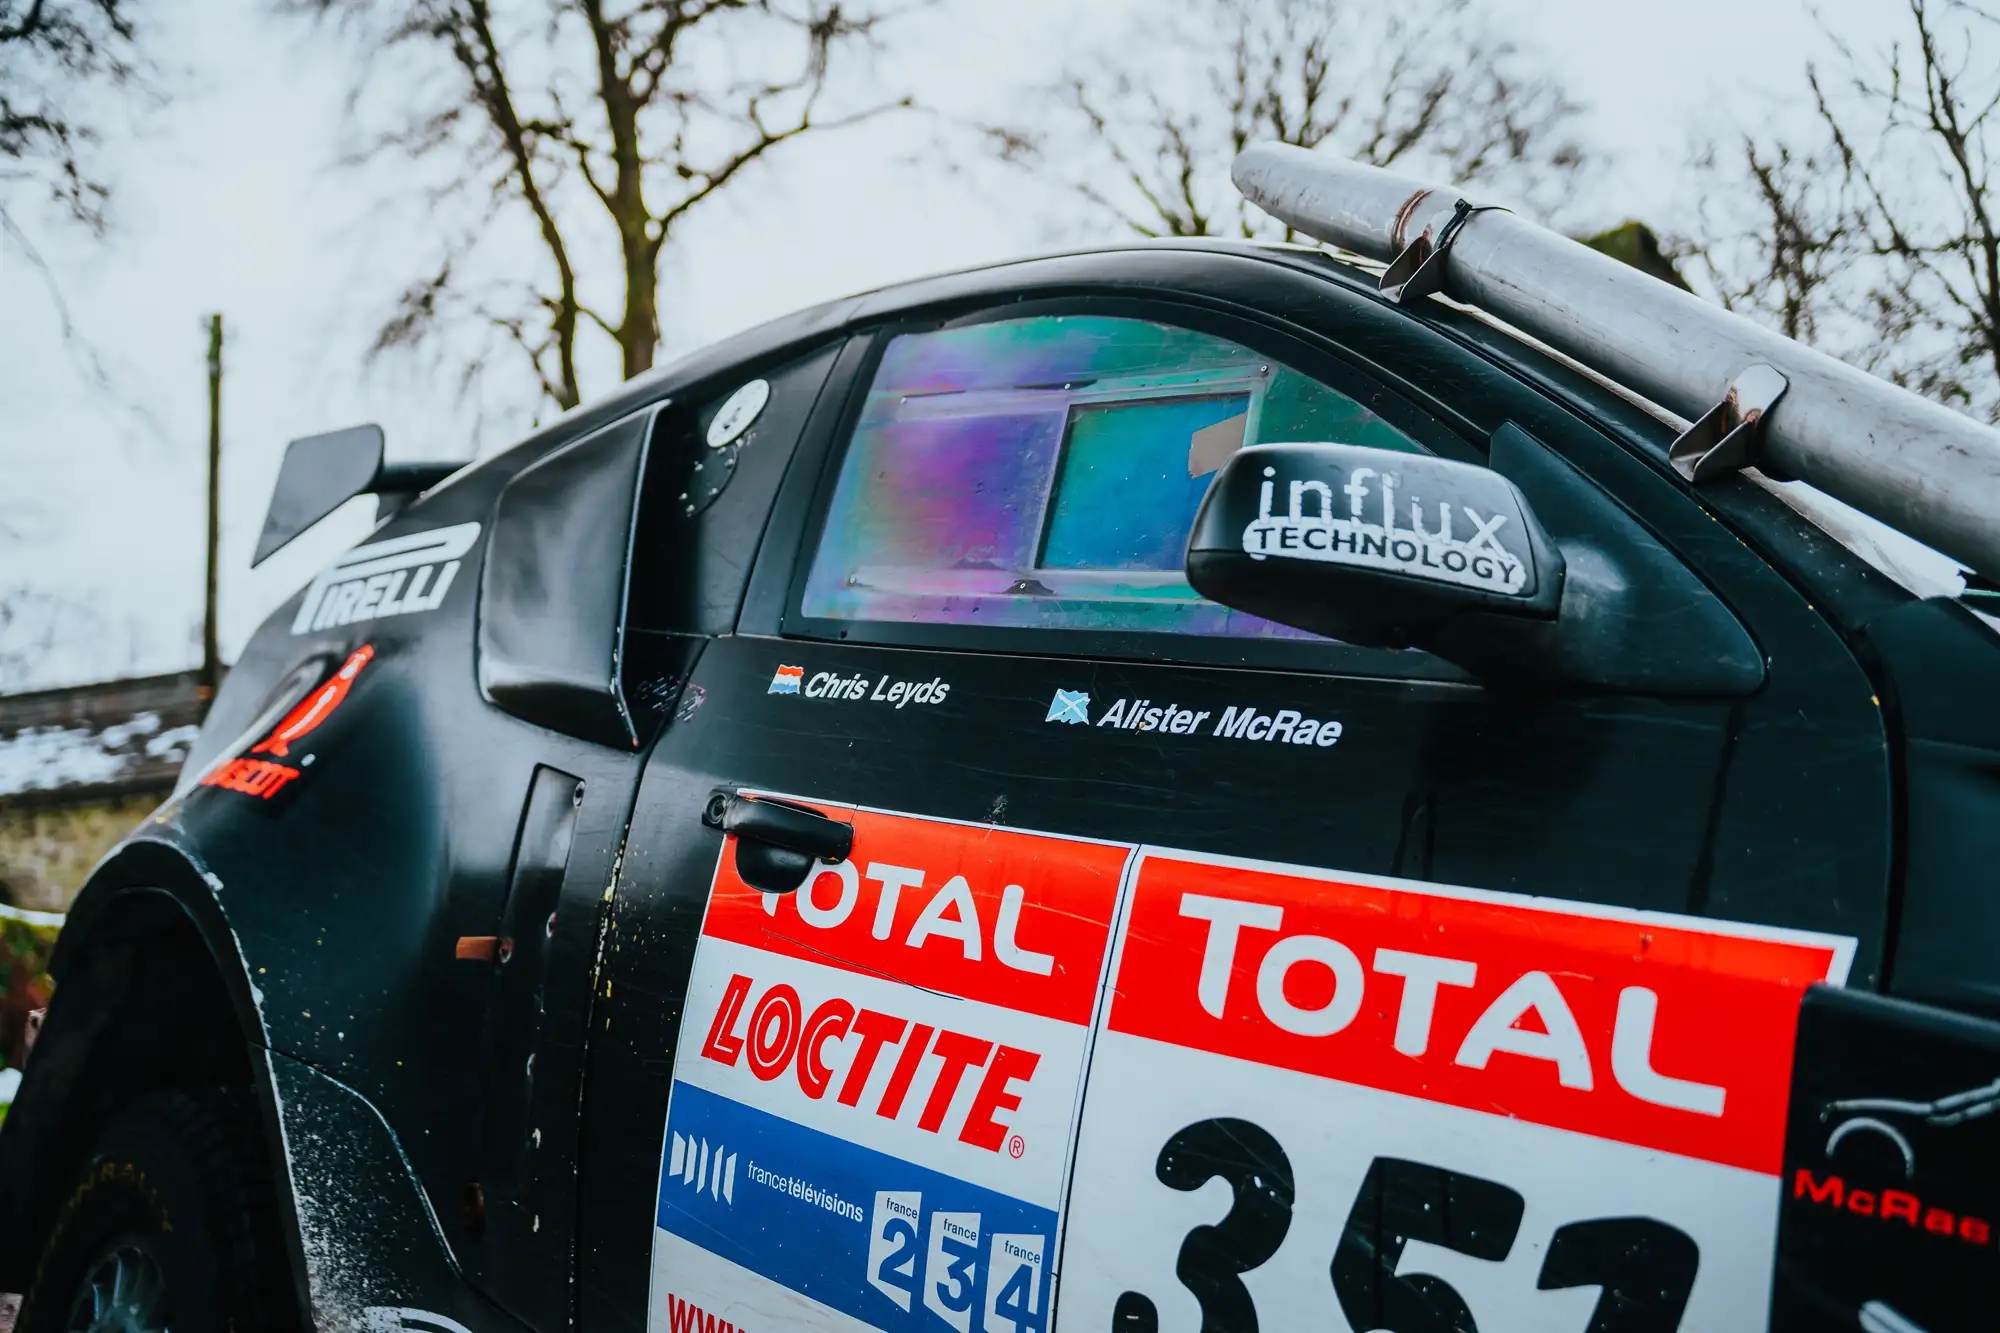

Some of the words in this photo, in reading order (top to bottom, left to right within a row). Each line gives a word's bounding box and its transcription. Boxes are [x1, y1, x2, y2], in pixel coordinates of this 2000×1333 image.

[1258, 465, 1516, 562] influx
[291, 521, 481, 635] PIRELLI
[1252, 527, 1517, 584] TECHNOLOGY
[804, 671, 869, 701] Chris
[870, 674, 951, 709] Leyds
[1097, 698, 1211, 735] Alister
[1213, 706, 1343, 747] McRae
[762, 858, 1055, 977] OTAL
[1178, 893, 1727, 1118] TOTAL
[701, 973, 1041, 1153] LOCTITE
[886, 1197, 918, 1219] france
[943, 1218, 977, 1241] france
[1794, 1168, 1989, 1244] McRae
[878, 1218, 917, 1293] 2
[937, 1236, 976, 1312] 3
[1004, 1240, 1041, 1263] france
[995, 1264, 1041, 1333] 4
